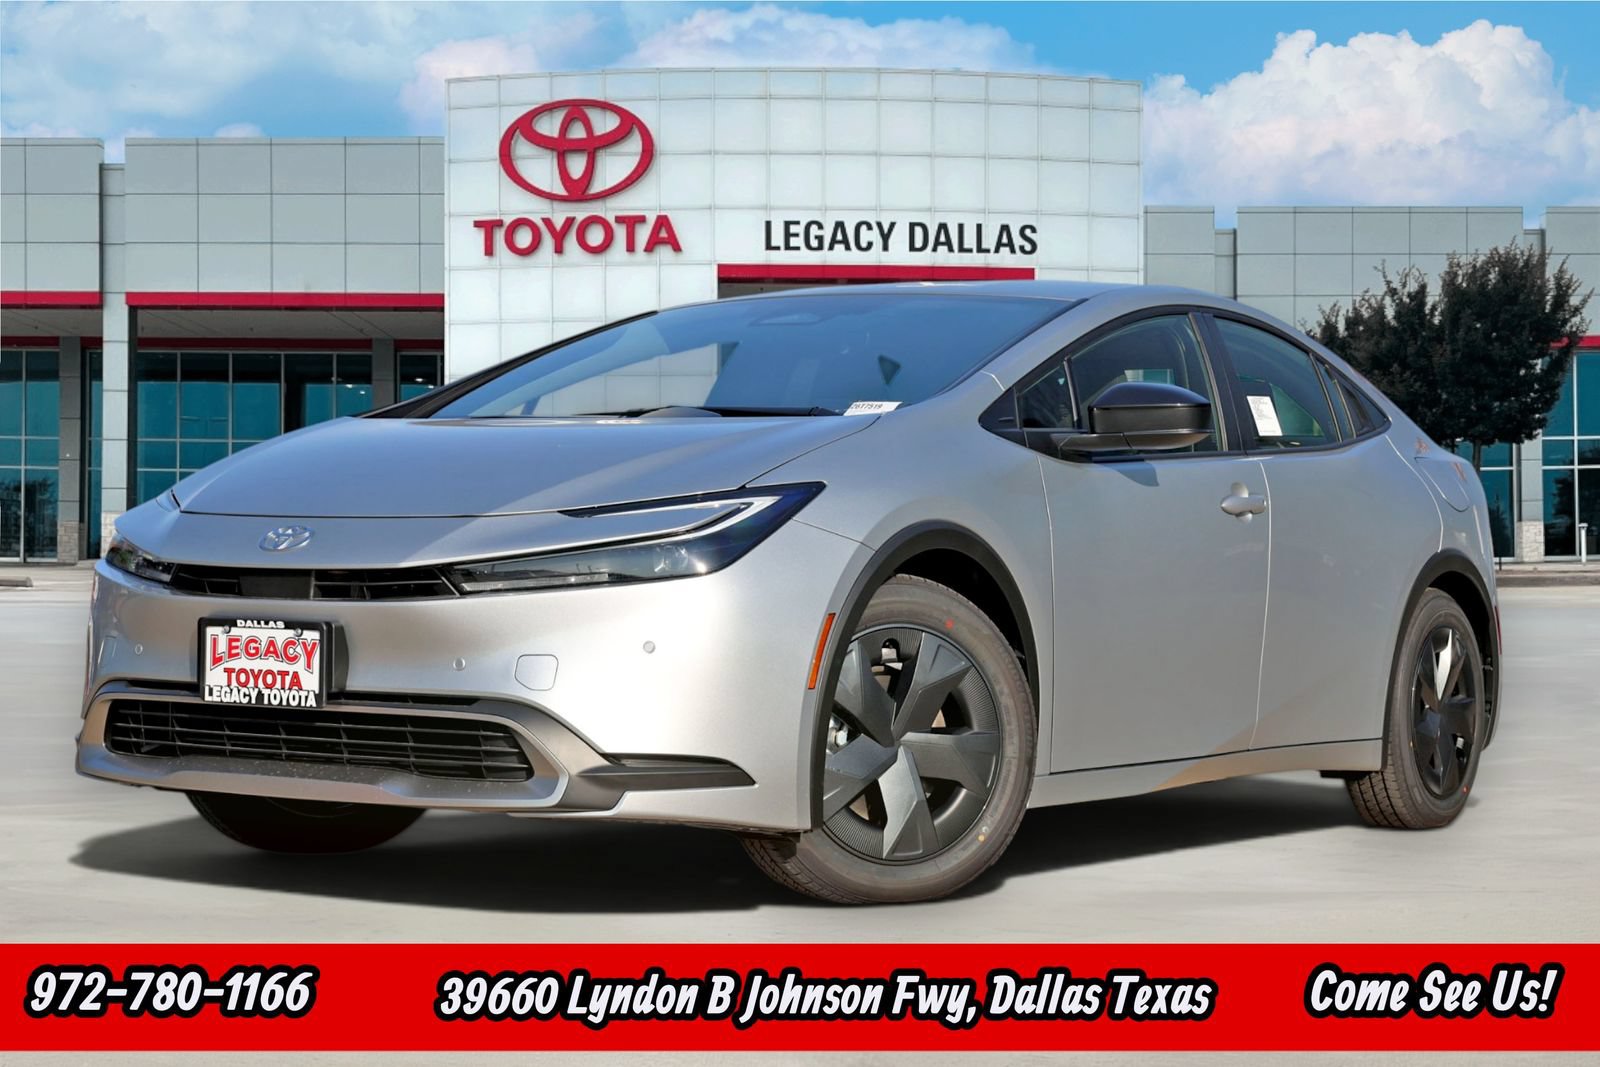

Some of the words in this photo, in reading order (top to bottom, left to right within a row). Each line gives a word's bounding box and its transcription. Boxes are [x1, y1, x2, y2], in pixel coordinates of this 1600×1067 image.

[475, 214, 682, 257] TOYOTA
[765, 220, 897, 252] LEGACY
[908, 221, 1038, 255] DALLAS
[236, 619, 286, 629] DALLAS
[210, 634, 320, 674] LEGACY
[223, 667, 304, 690] TOYOTA
[204, 685, 259, 704] LEGACY
[261, 688, 317, 707] TOYOTA
